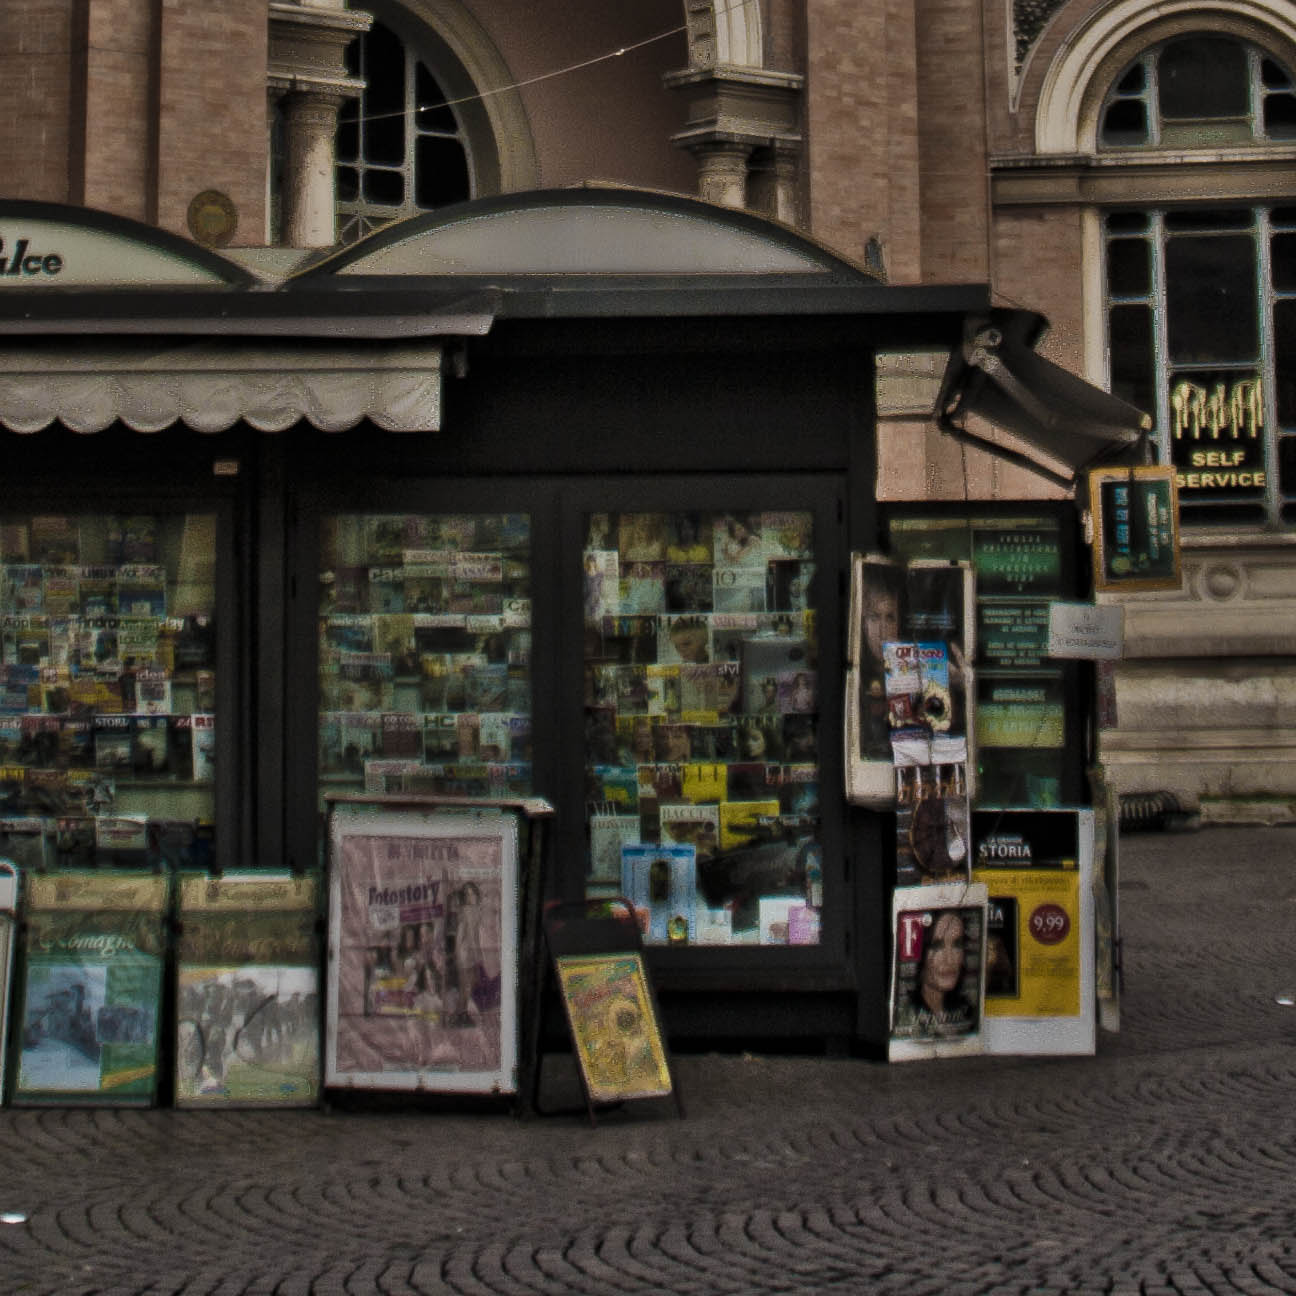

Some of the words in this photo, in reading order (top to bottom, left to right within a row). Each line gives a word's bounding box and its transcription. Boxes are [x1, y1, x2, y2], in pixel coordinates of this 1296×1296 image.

[1191, 450, 1246, 467] SELF
[1175, 472, 1266, 488] SERVICE
[979, 844, 1031, 857] STORIA
[369, 879, 441, 905] Fotostory
